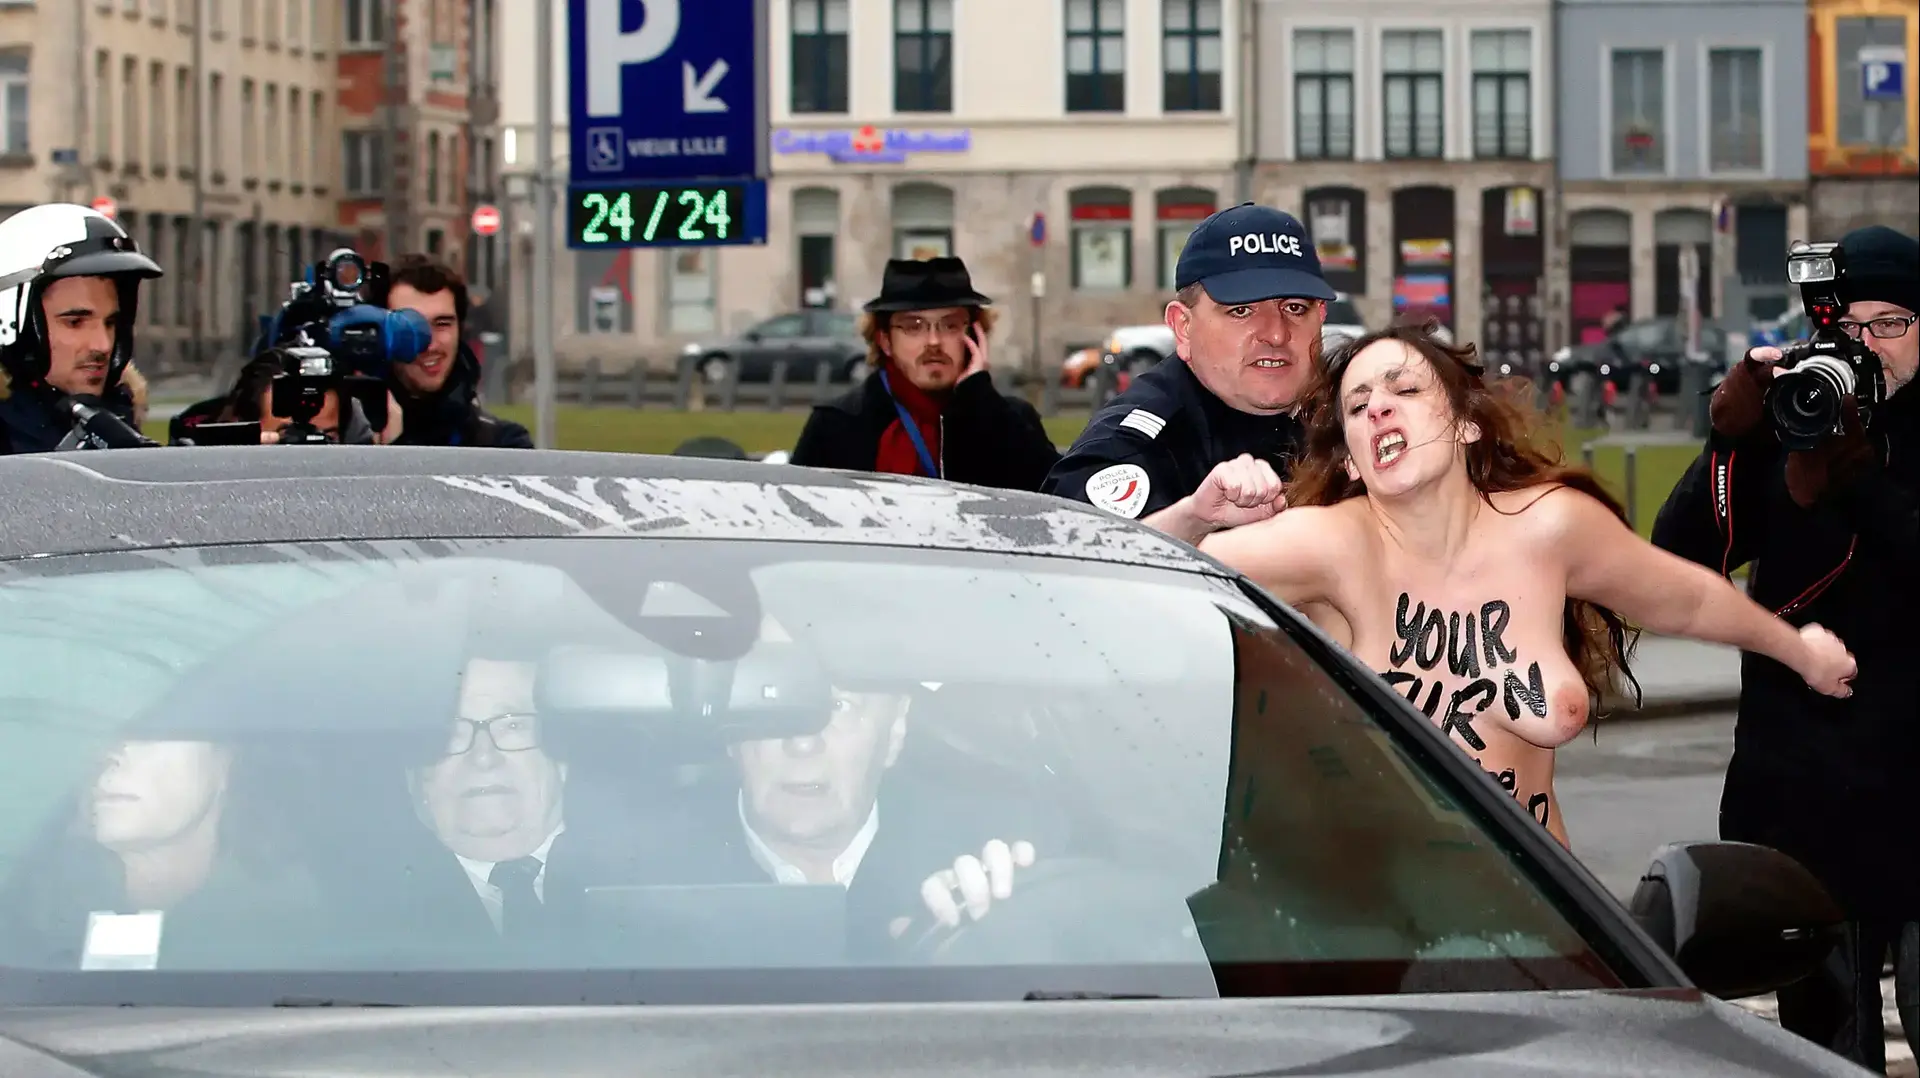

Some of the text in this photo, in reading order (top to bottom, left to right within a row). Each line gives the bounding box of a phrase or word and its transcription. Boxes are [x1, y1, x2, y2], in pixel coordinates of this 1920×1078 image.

[586, 0, 681, 117] P
[1866, 63, 1890, 91] P
[626, 135, 727, 157] VIEUX LILLE
[1229, 233, 1303, 257] POLICE
[1717, 465, 1726, 517] Canon
[1390, 592, 1517, 679] YOUR
